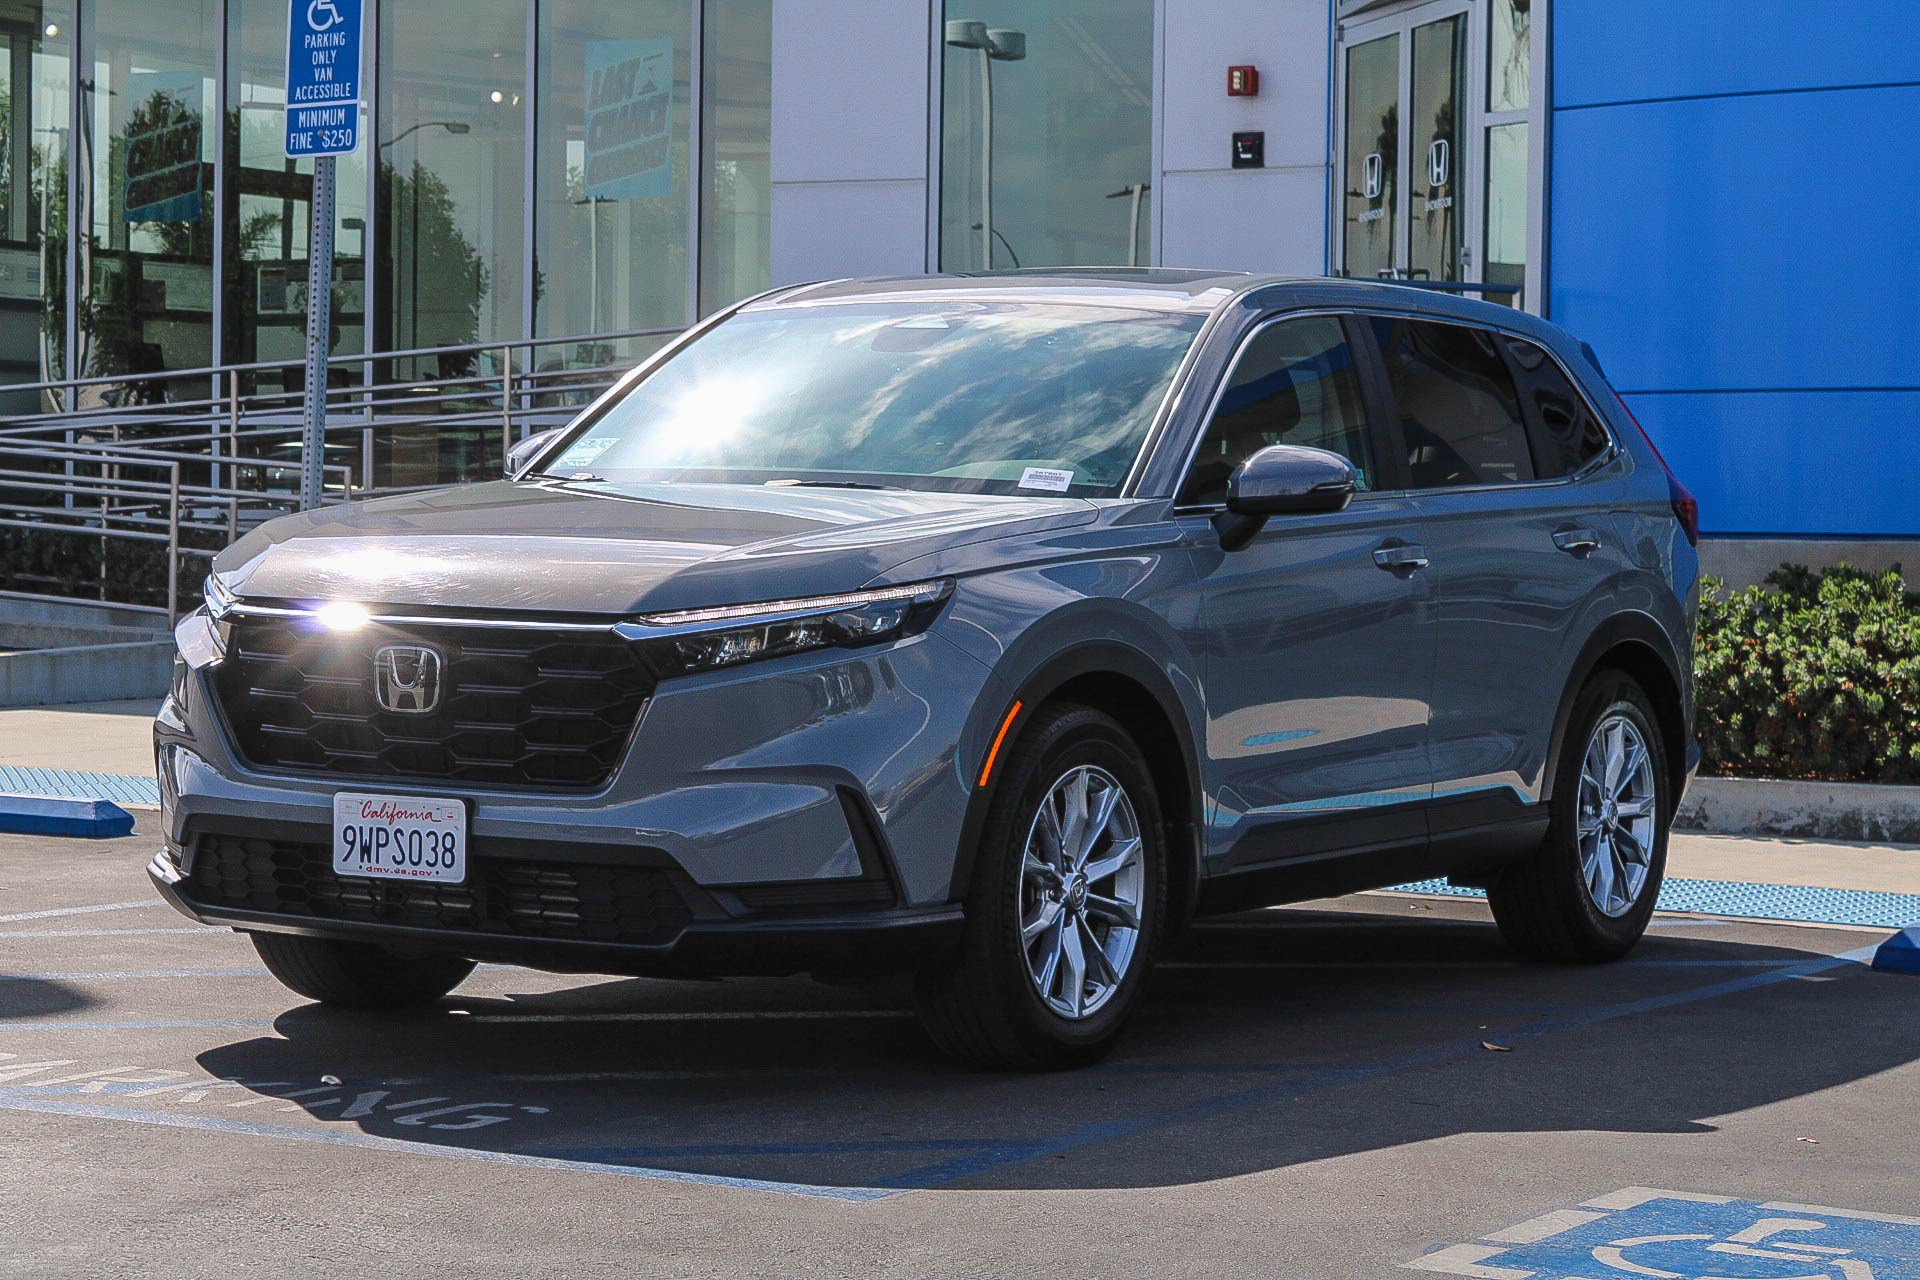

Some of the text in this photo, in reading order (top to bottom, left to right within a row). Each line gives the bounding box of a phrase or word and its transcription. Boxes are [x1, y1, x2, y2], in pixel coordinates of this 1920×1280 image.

[304, 31, 346, 49] PARKING
[311, 49, 337, 65] ONLY
[314, 67, 333, 82] VAN
[588, 57, 641, 111] LAST
[294, 82, 351, 101] ACCESSIBLE
[298, 108, 346, 129] MINIMUM
[290, 129, 353, 150] FINE $250
[361, 800, 442, 825] California
[341, 825, 456, 869] 9WPS038
[365, 865, 433, 877] dmv.ca.gov
